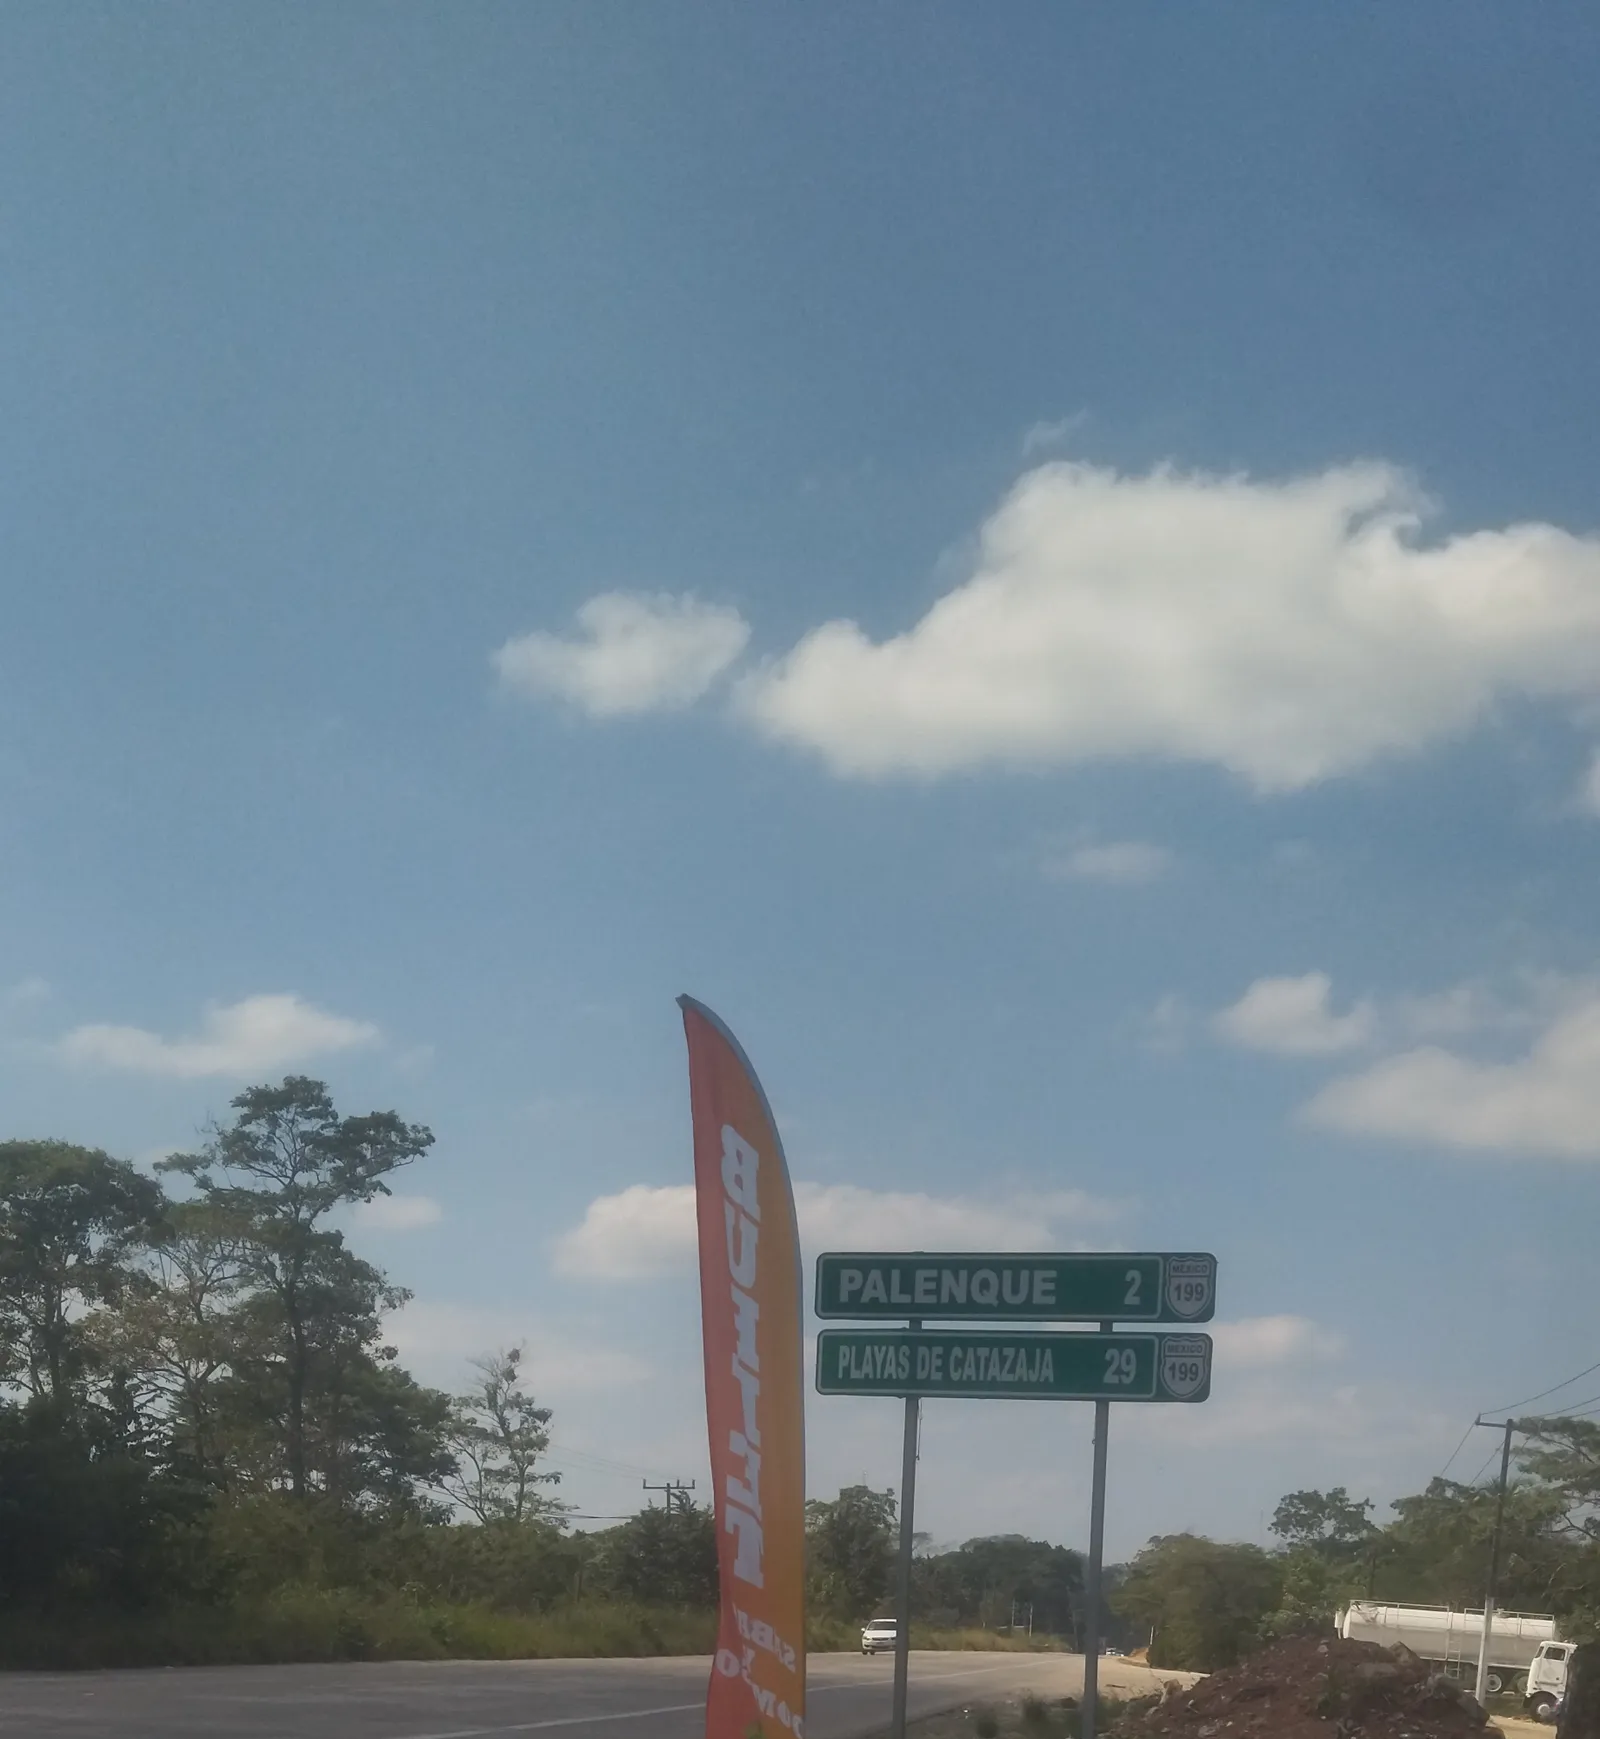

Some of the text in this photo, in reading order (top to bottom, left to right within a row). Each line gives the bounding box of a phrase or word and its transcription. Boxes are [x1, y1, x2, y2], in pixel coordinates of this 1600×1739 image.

[838, 1268, 1142, 1307] PALENQUE 2
[1173, 1282, 1205, 1302] 199
[837, 1345, 1137, 1384] PLAYAS DE CATAZAJA 29
[1167, 1362, 1200, 1382] 199
